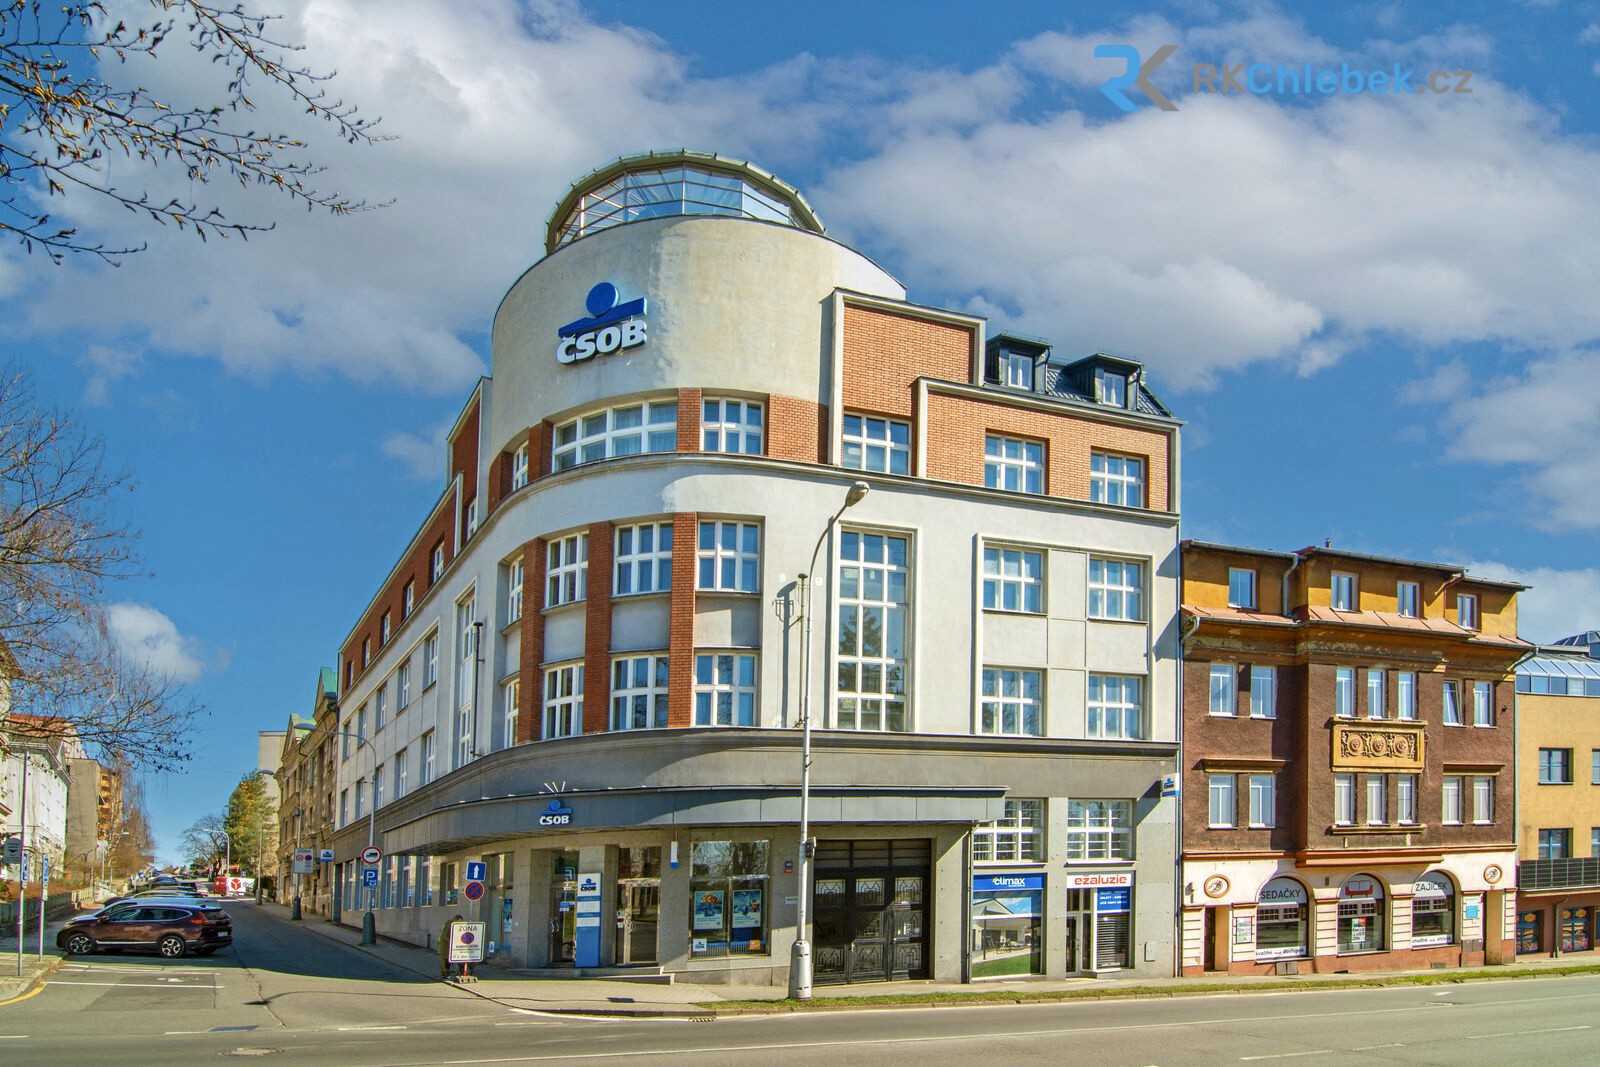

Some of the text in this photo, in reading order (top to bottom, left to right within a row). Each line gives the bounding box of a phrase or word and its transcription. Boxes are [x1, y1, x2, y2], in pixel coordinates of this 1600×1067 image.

[556, 319, 648, 366] ČSOB
[539, 815, 570, 825] ČSOB
[994, 876, 1025, 885] climax
[1074, 874, 1127, 885] ežaluzie
[1415, 881, 1448, 891] ZAJÍČEK
[1261, 888, 1301, 899] SEDAČKY
